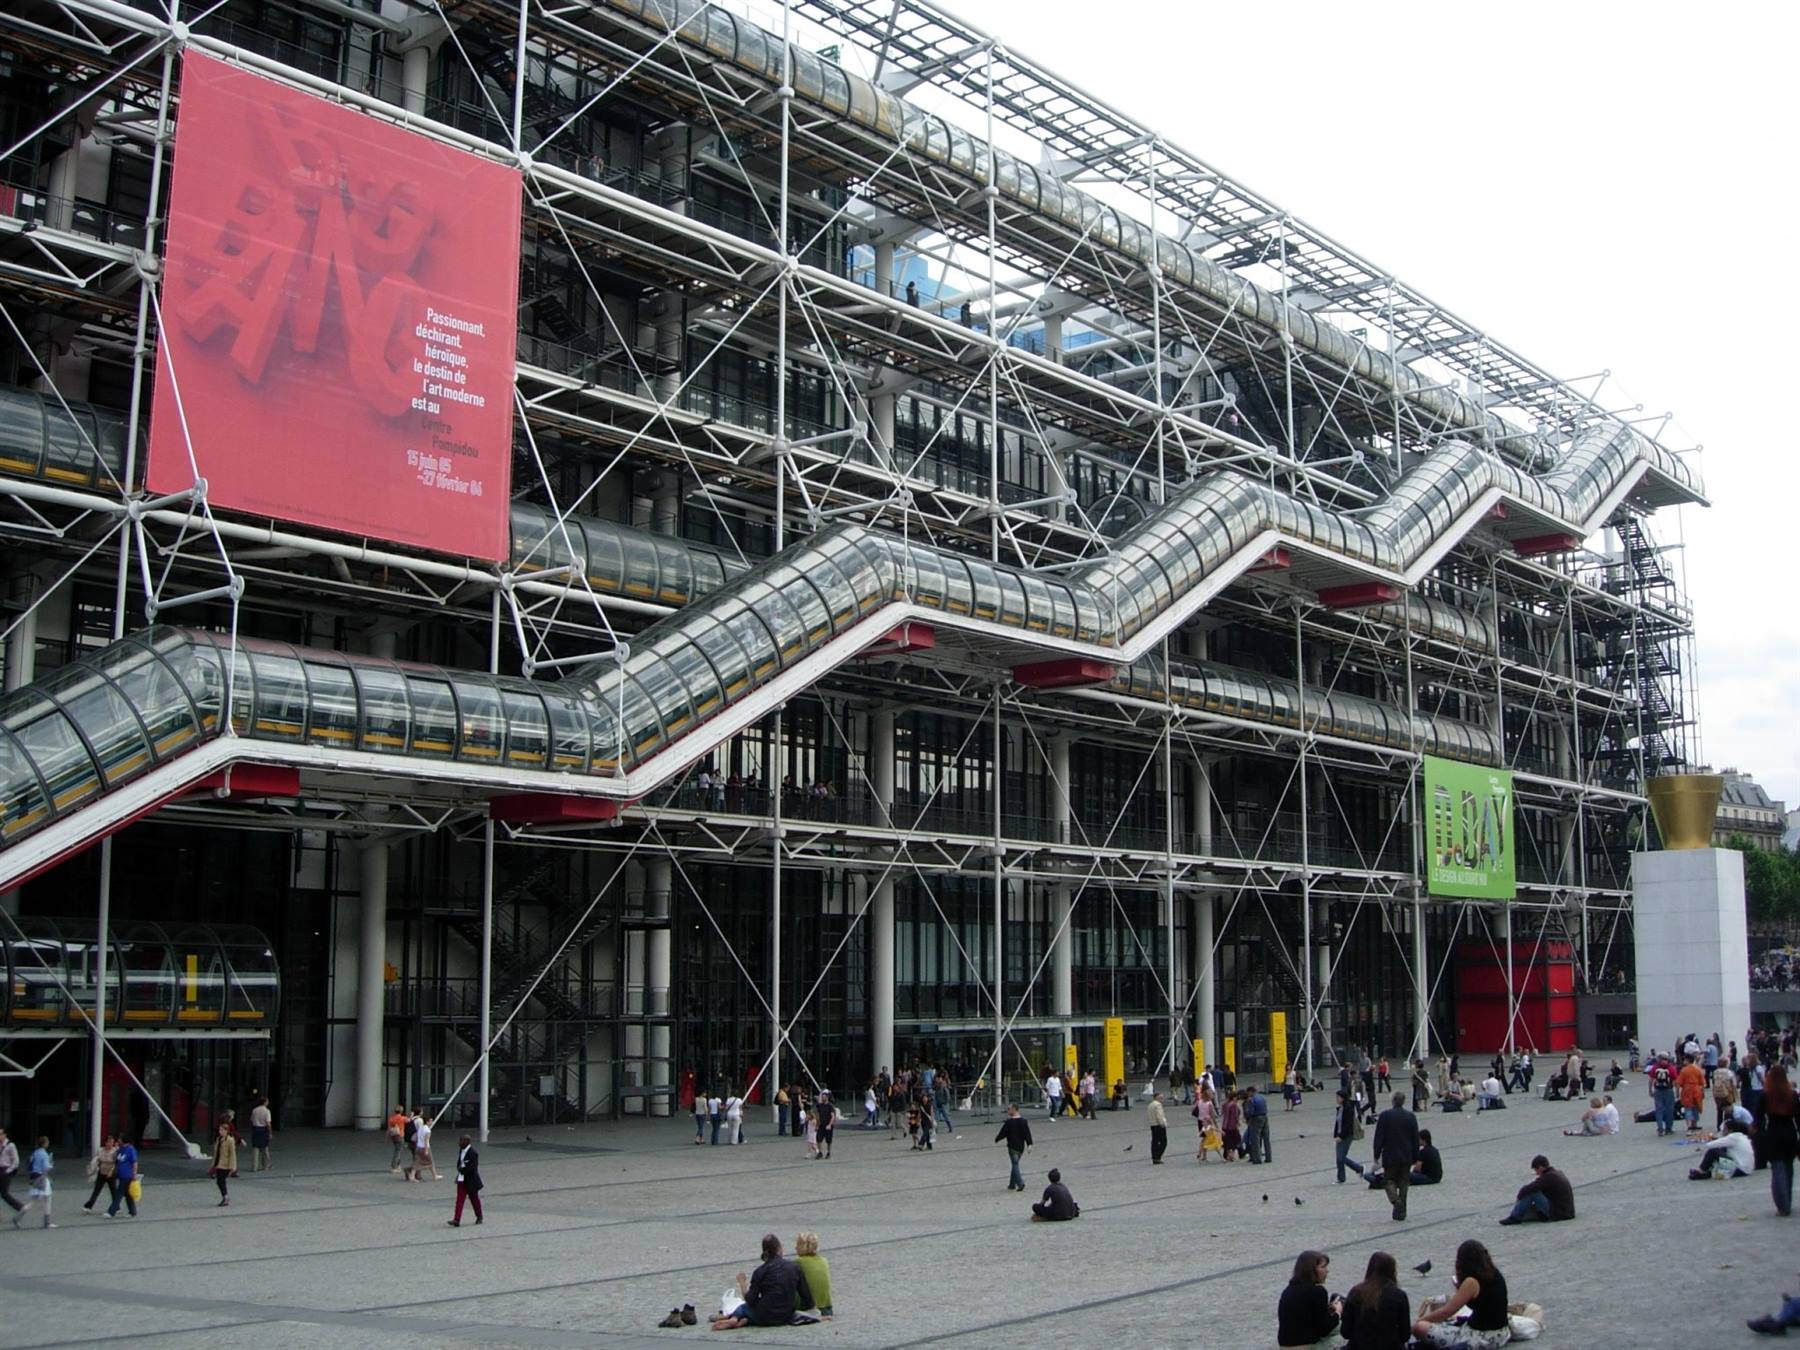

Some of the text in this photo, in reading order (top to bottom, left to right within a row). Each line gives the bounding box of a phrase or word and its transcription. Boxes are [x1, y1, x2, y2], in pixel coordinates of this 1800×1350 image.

[427, 308, 485, 337] Passionnant,
[415, 323, 462, 348] déchirant,
[425, 343, 469, 368] héroïque,
[413, 358, 466, 384] le destin de
[411, 397, 440, 414] est au
[423, 379, 485, 407] l'art moderne
[421, 416, 452, 434] Centre
[432, 435, 479, 458] Pompidou
